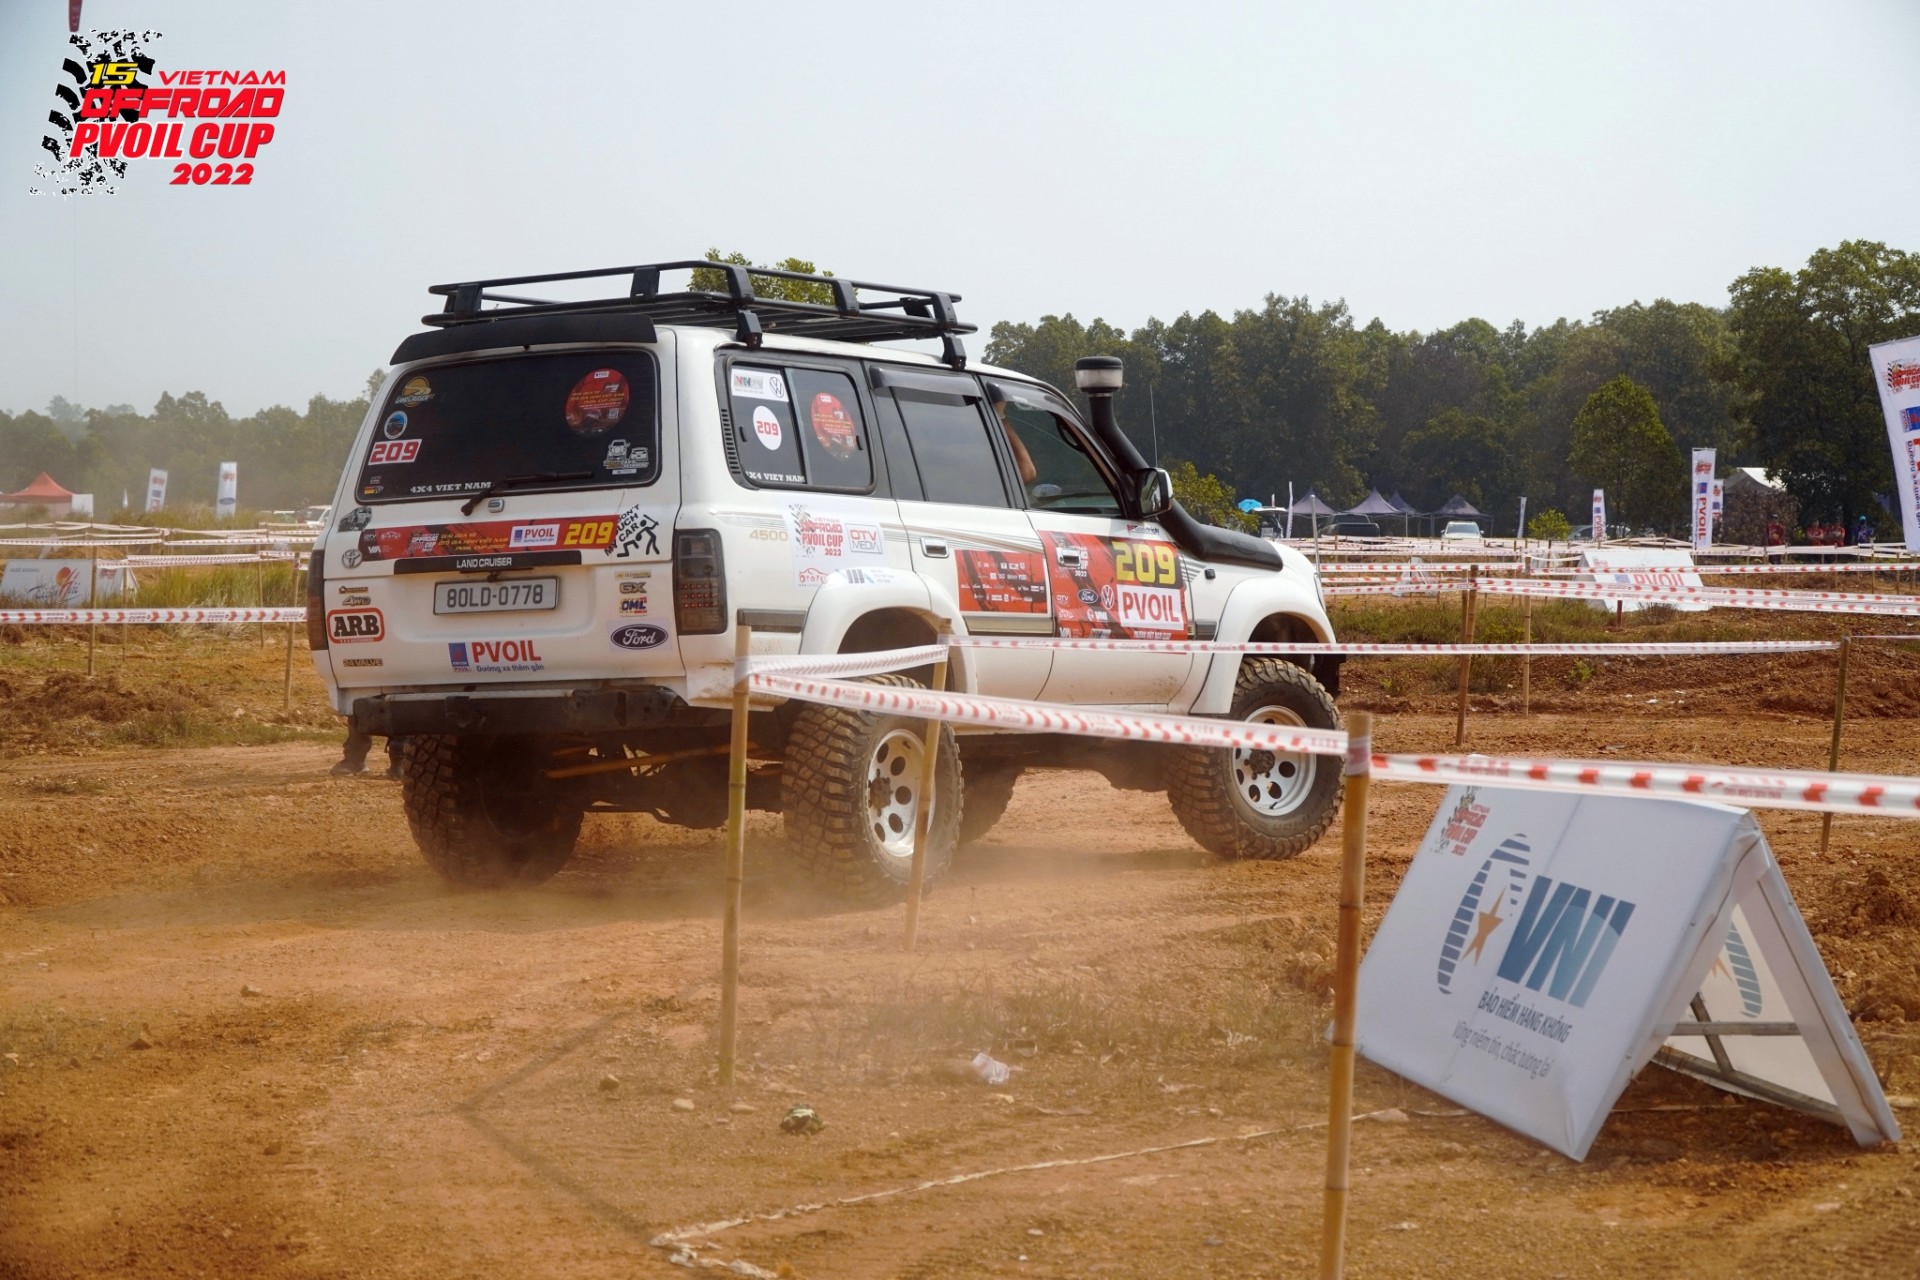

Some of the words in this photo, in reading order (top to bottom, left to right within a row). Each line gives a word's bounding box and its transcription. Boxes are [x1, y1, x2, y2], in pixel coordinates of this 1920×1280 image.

[756, 420, 779, 436] 209
[370, 441, 419, 463] 209
[764, 472, 784, 481] VIET
[410, 485, 433, 494] 4X4
[435, 483, 462, 492] VIET
[464, 482, 492, 490] NAM
[1699, 497, 1707, 539] PVOIL
[525, 528, 554, 538] PVOIL
[564, 521, 614, 545] 209
[619, 522, 640, 542] CAR
[749, 529, 788, 541] 4500
[802, 534, 825, 546] PVOIL
[826, 534, 844, 547] CUP
[850, 529, 877, 541] OTV
[456, 559, 478, 568] LAND
[479, 557, 512, 567] CRUISER
[1112, 541, 1176, 584] 209
[446, 584, 543, 609] 80LD-0778
[620, 582, 647, 594] GX
[1123, 592, 1180, 622] PVOIL
[334, 615, 380, 637] ARB
[623, 628, 656, 645] Ford
[471, 640, 542, 663] PVOIL
[1497, 875, 1636, 1008] VNI
